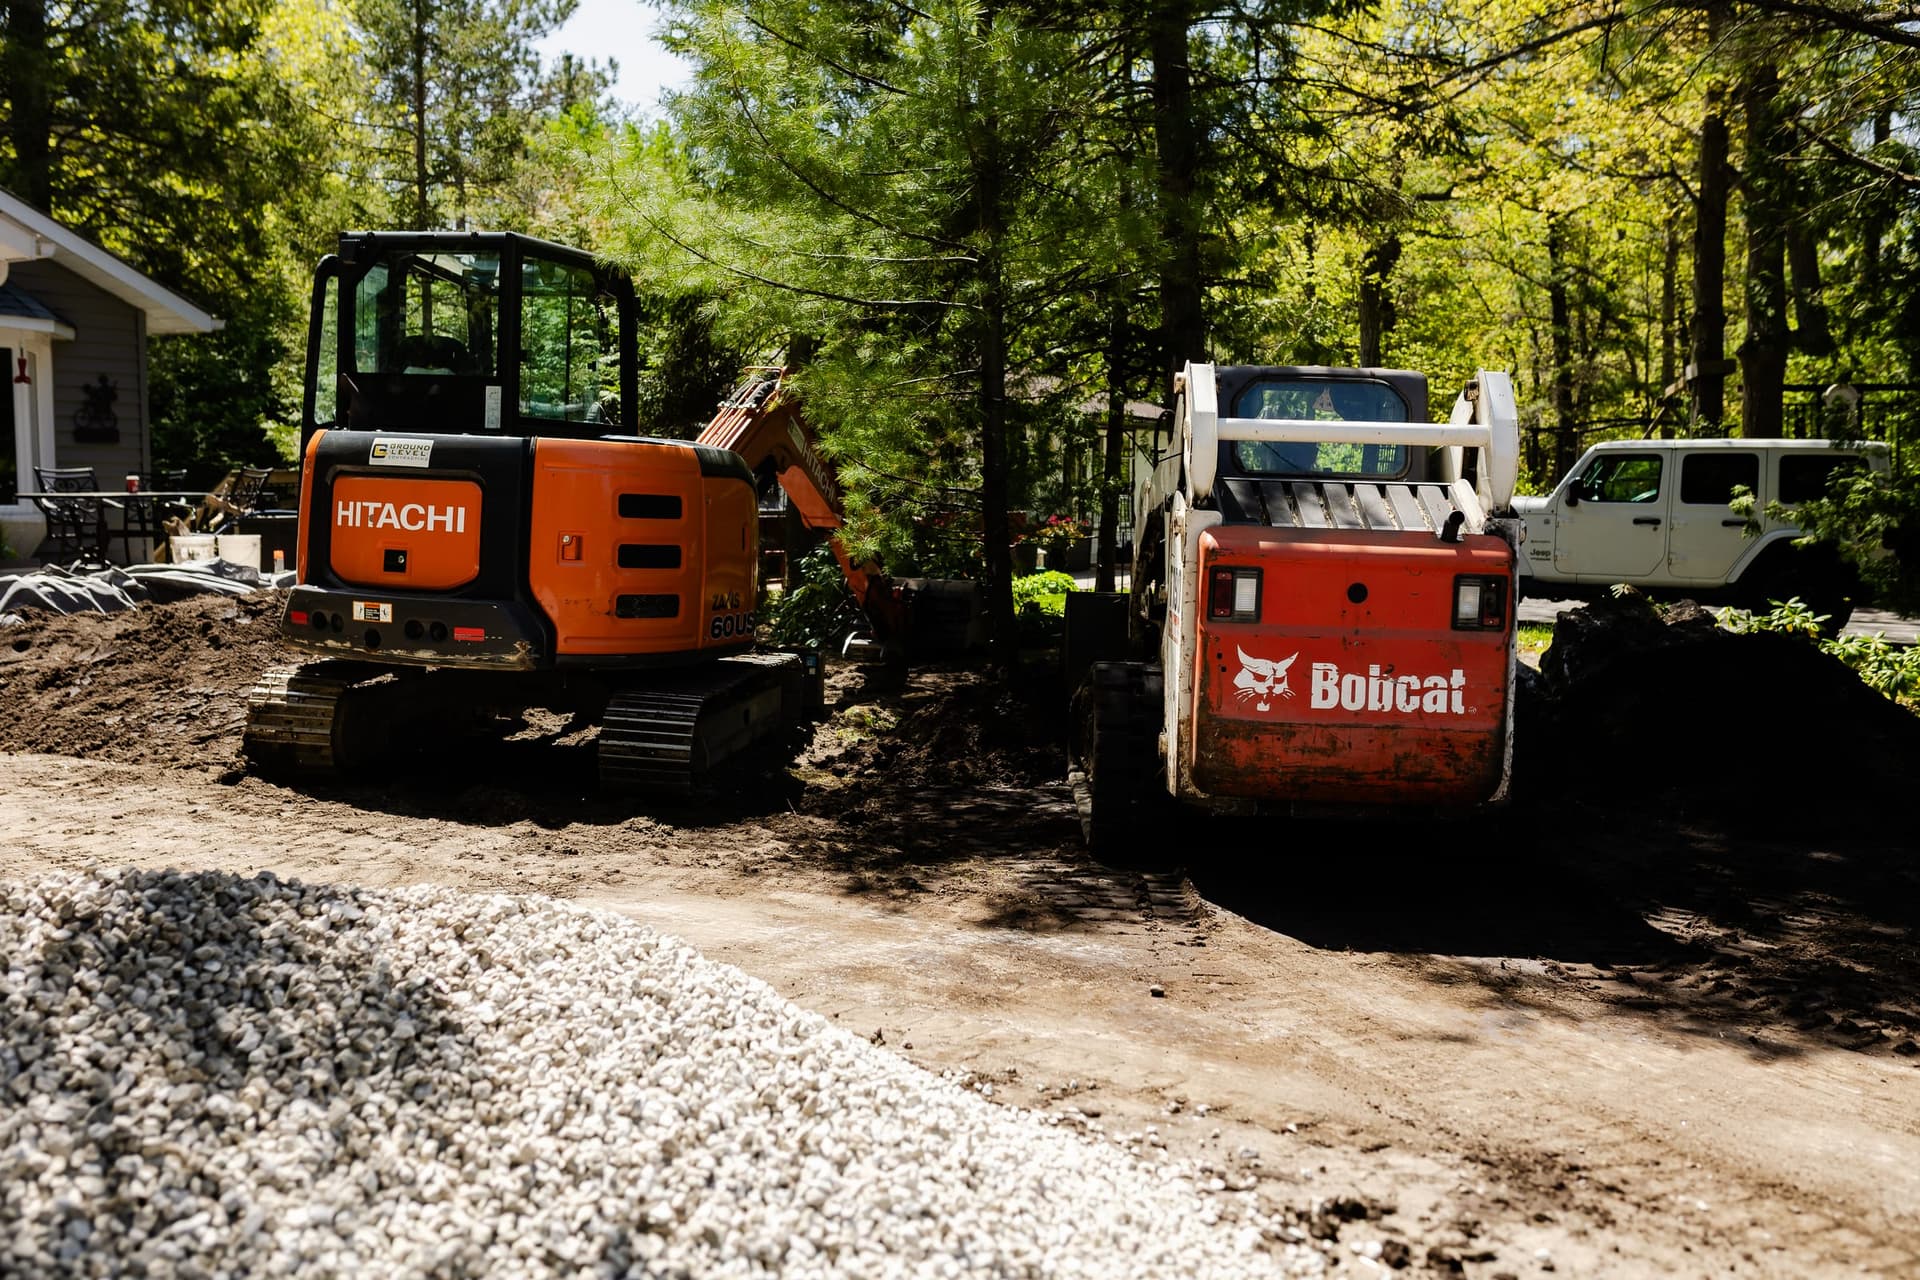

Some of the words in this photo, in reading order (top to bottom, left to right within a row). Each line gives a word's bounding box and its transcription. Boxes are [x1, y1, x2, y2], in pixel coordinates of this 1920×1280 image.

[390, 443, 431, 451] GROUND
[391, 449, 426, 457] LEVEL
[803, 443, 834, 502] HITACHI
[337, 501, 466, 533] HITACHI
[1530, 548, 1551, 557] Jeep
[712, 592, 740, 610] ZAXIS
[1310, 662, 1466, 714] Bobcat
